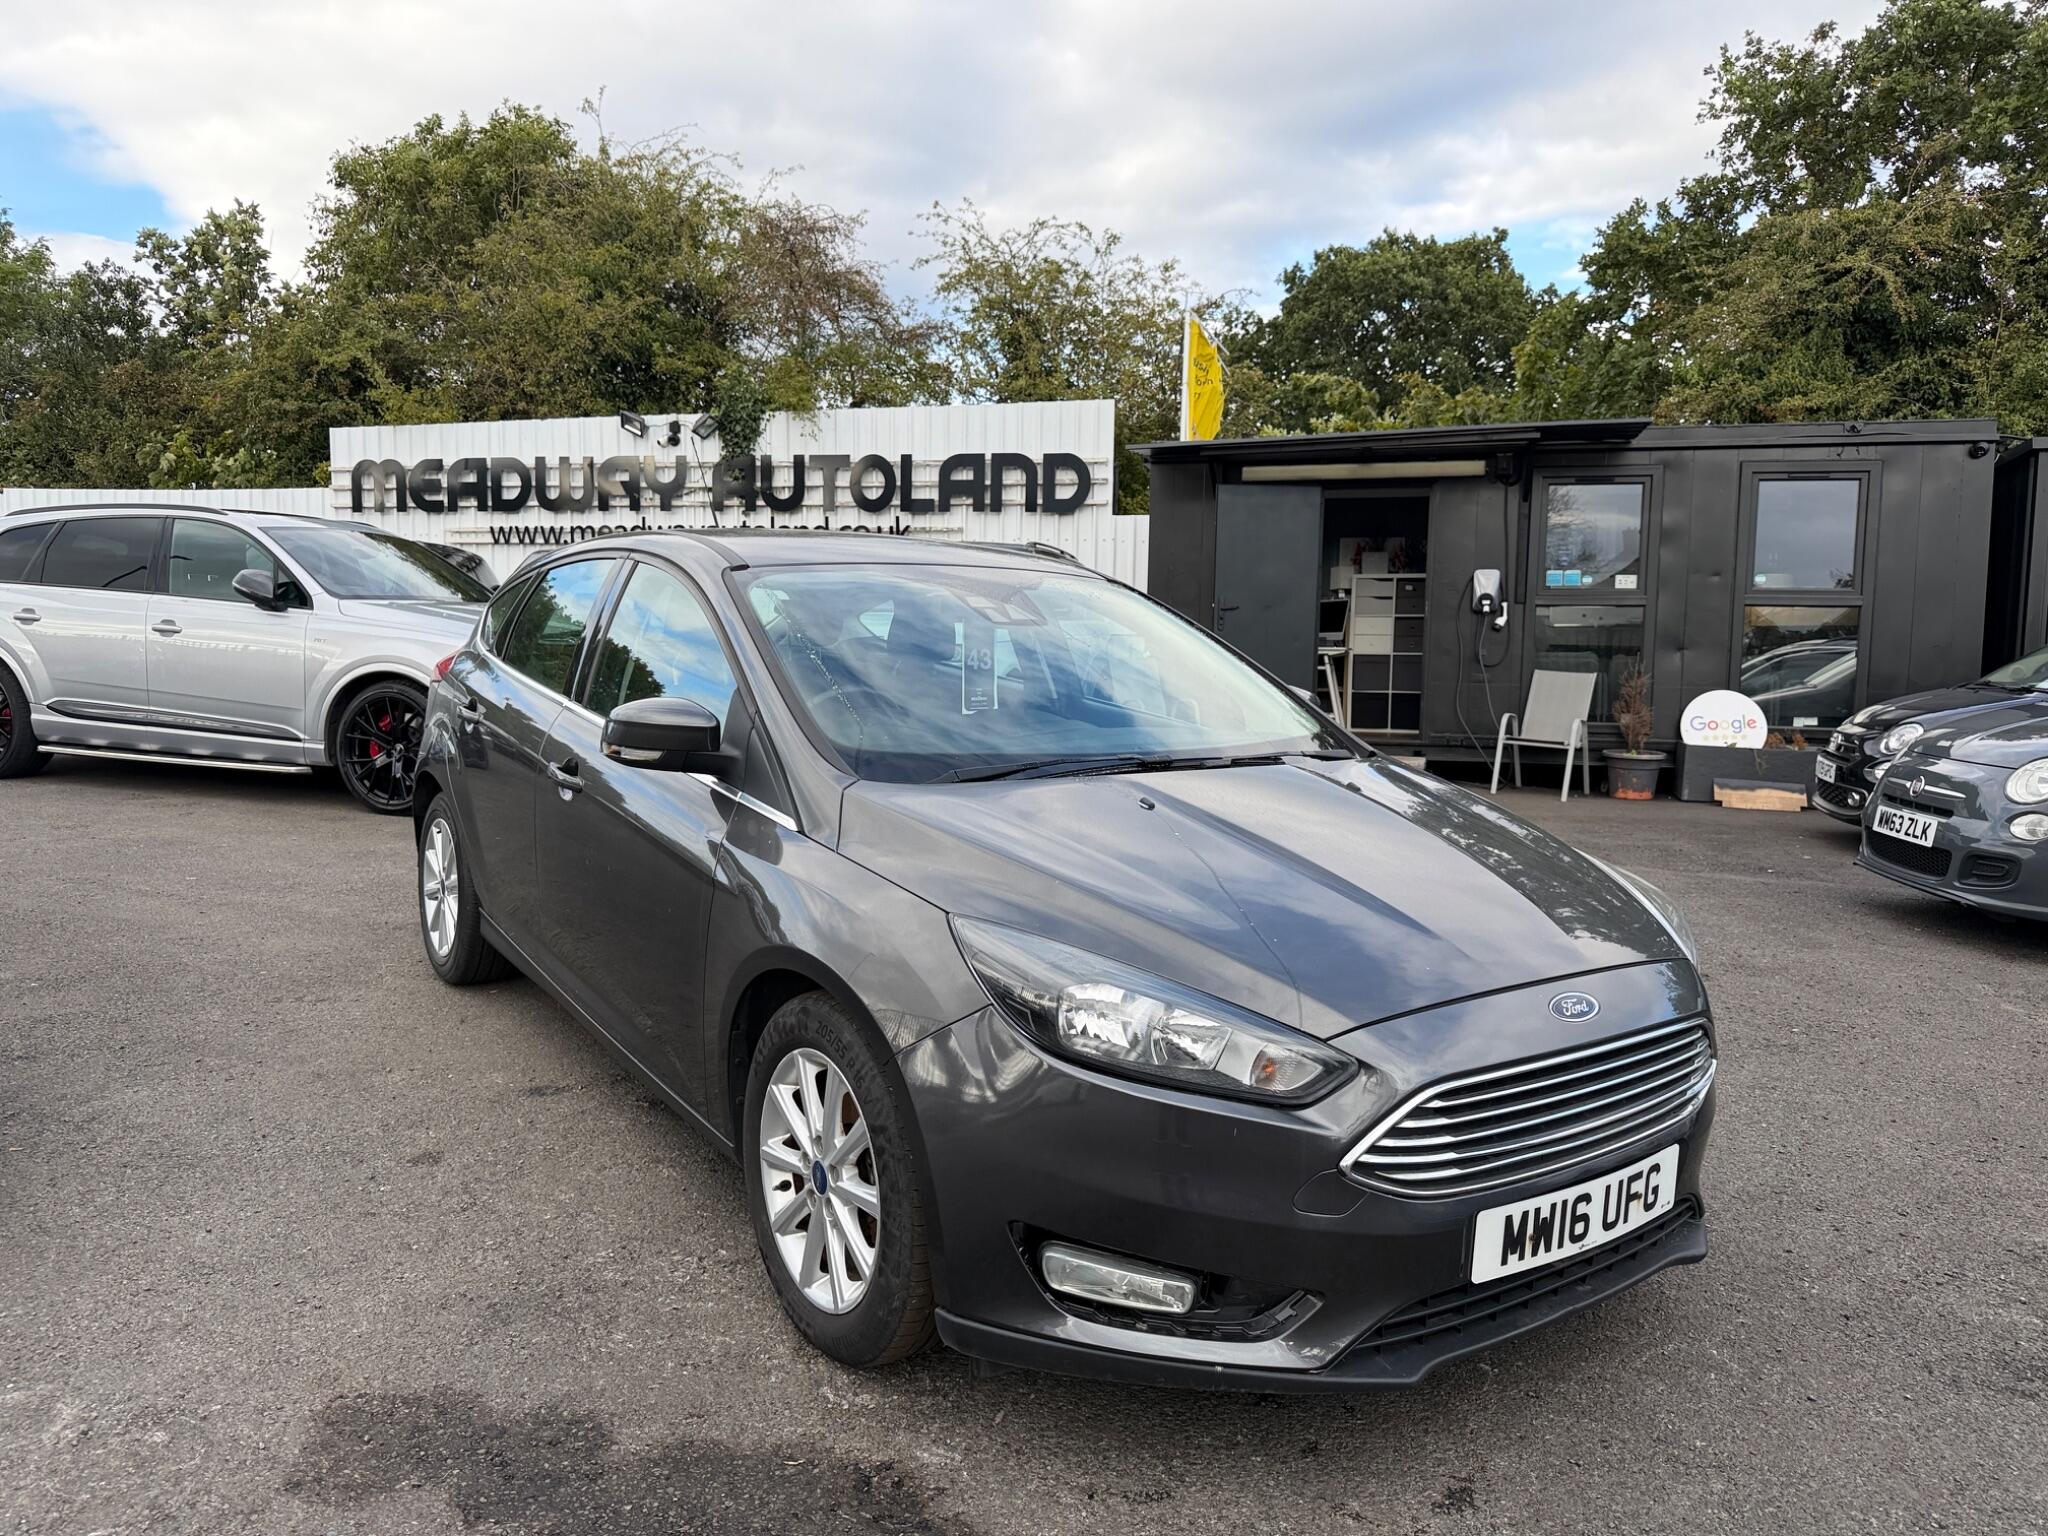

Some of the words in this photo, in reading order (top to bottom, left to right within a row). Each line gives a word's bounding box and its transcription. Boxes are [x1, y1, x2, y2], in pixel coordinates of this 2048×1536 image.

[352, 455, 687, 513] MEADWAY
[711, 453, 1091, 514] AUTOLAND
[967, 649, 992, 670] 43
[1690, 714, 1757, 733] Google
[1904, 817, 1932, 842] ZLK
[1561, 998, 1589, 1016] Ford
[815, 1020, 848, 1058] 205/55
[1500, 1192, 1592, 1267] MW16
[1602, 1162, 1661, 1232] UFG
